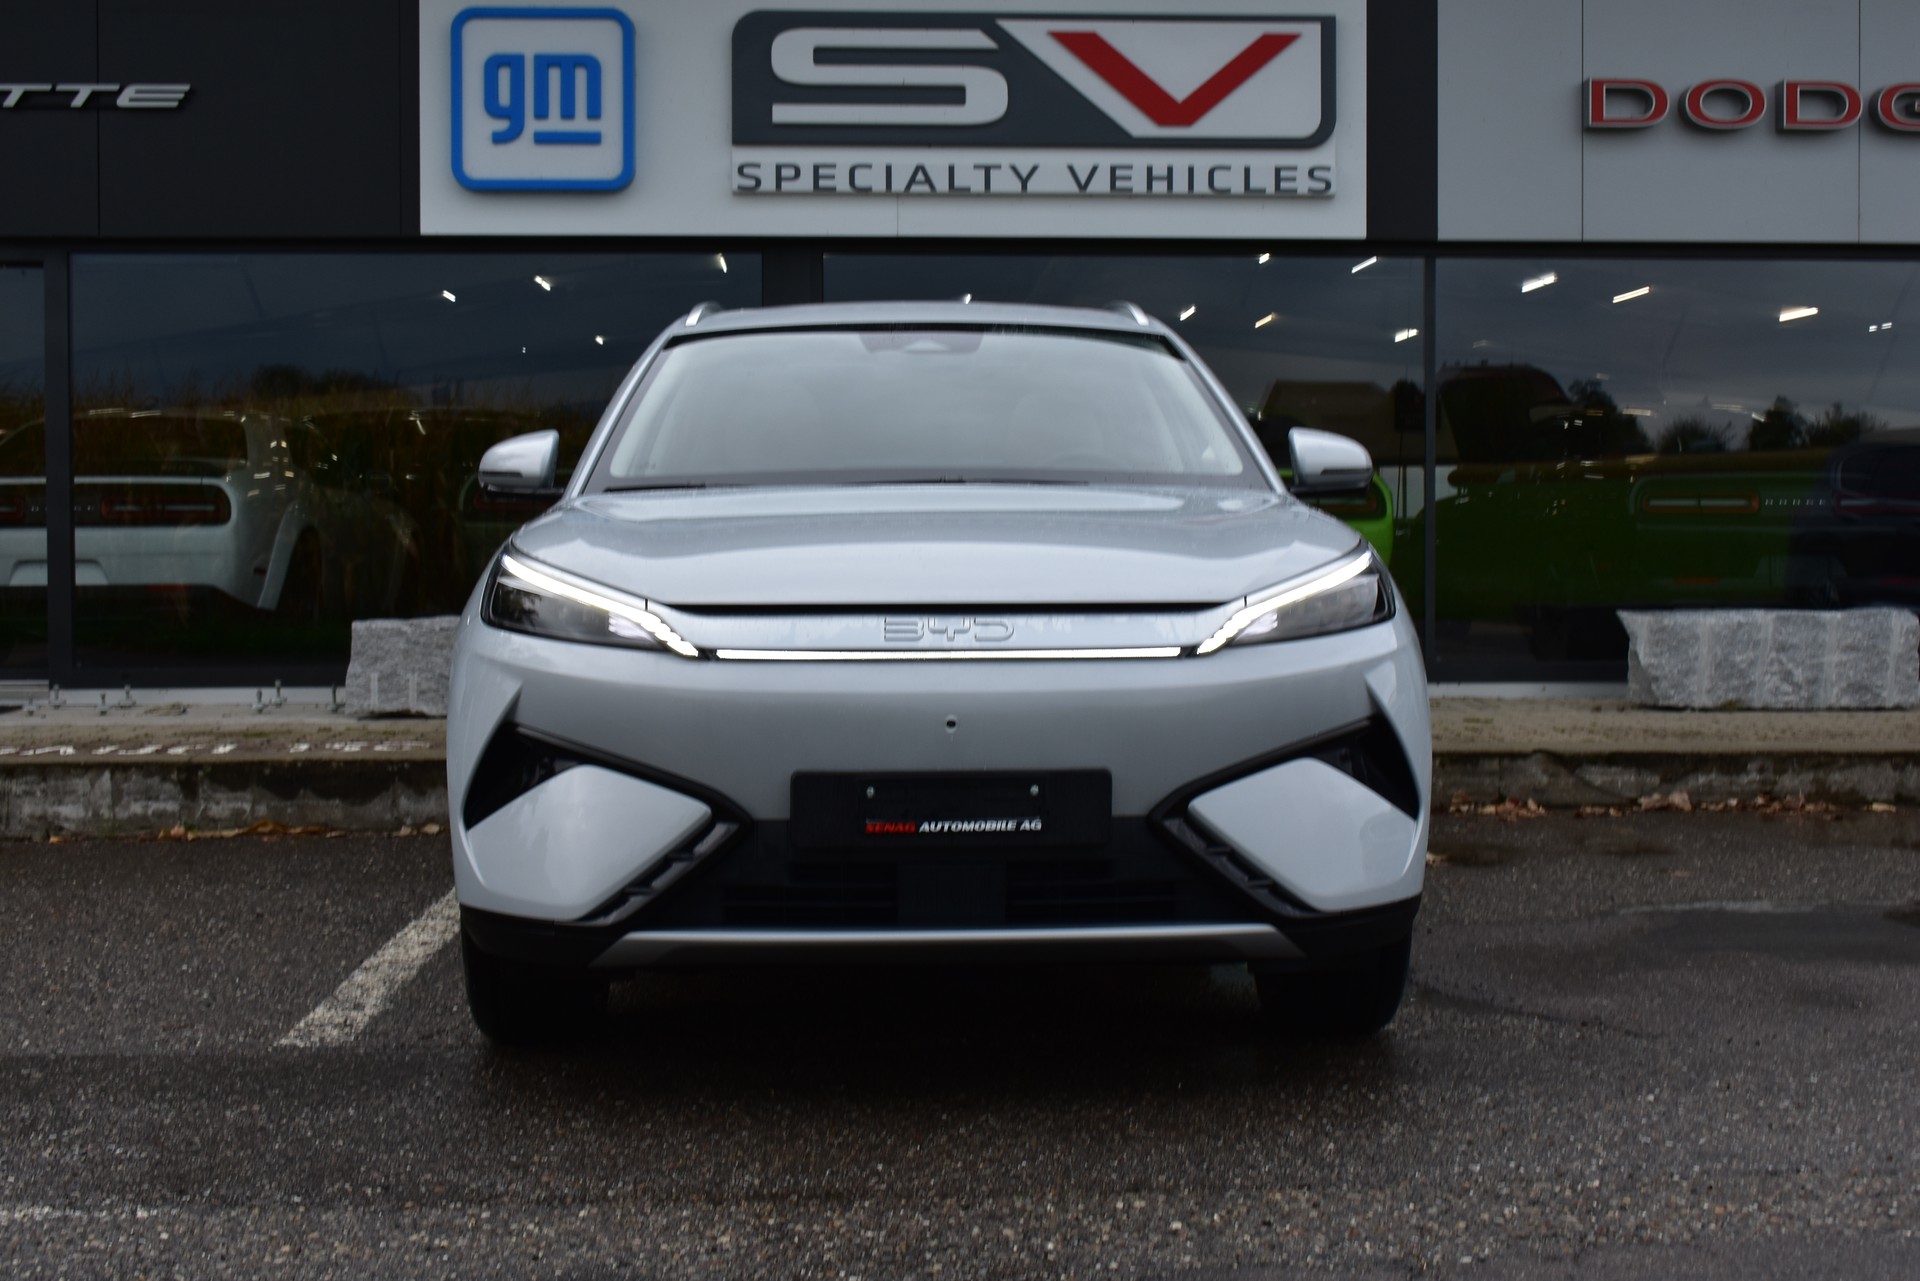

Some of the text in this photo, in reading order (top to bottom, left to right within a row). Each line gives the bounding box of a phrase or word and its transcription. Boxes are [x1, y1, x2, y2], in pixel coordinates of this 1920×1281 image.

[770, 27, 1302, 127] SV
[0, 83, 191, 108] TTE
[736, 162, 1333, 194] SPECIALTY VEHICLES
[884, 616, 1015, 642] BYD
[918, 819, 1018, 833] AUTOMOBILE
[1019, 818, 1043, 832] AG
